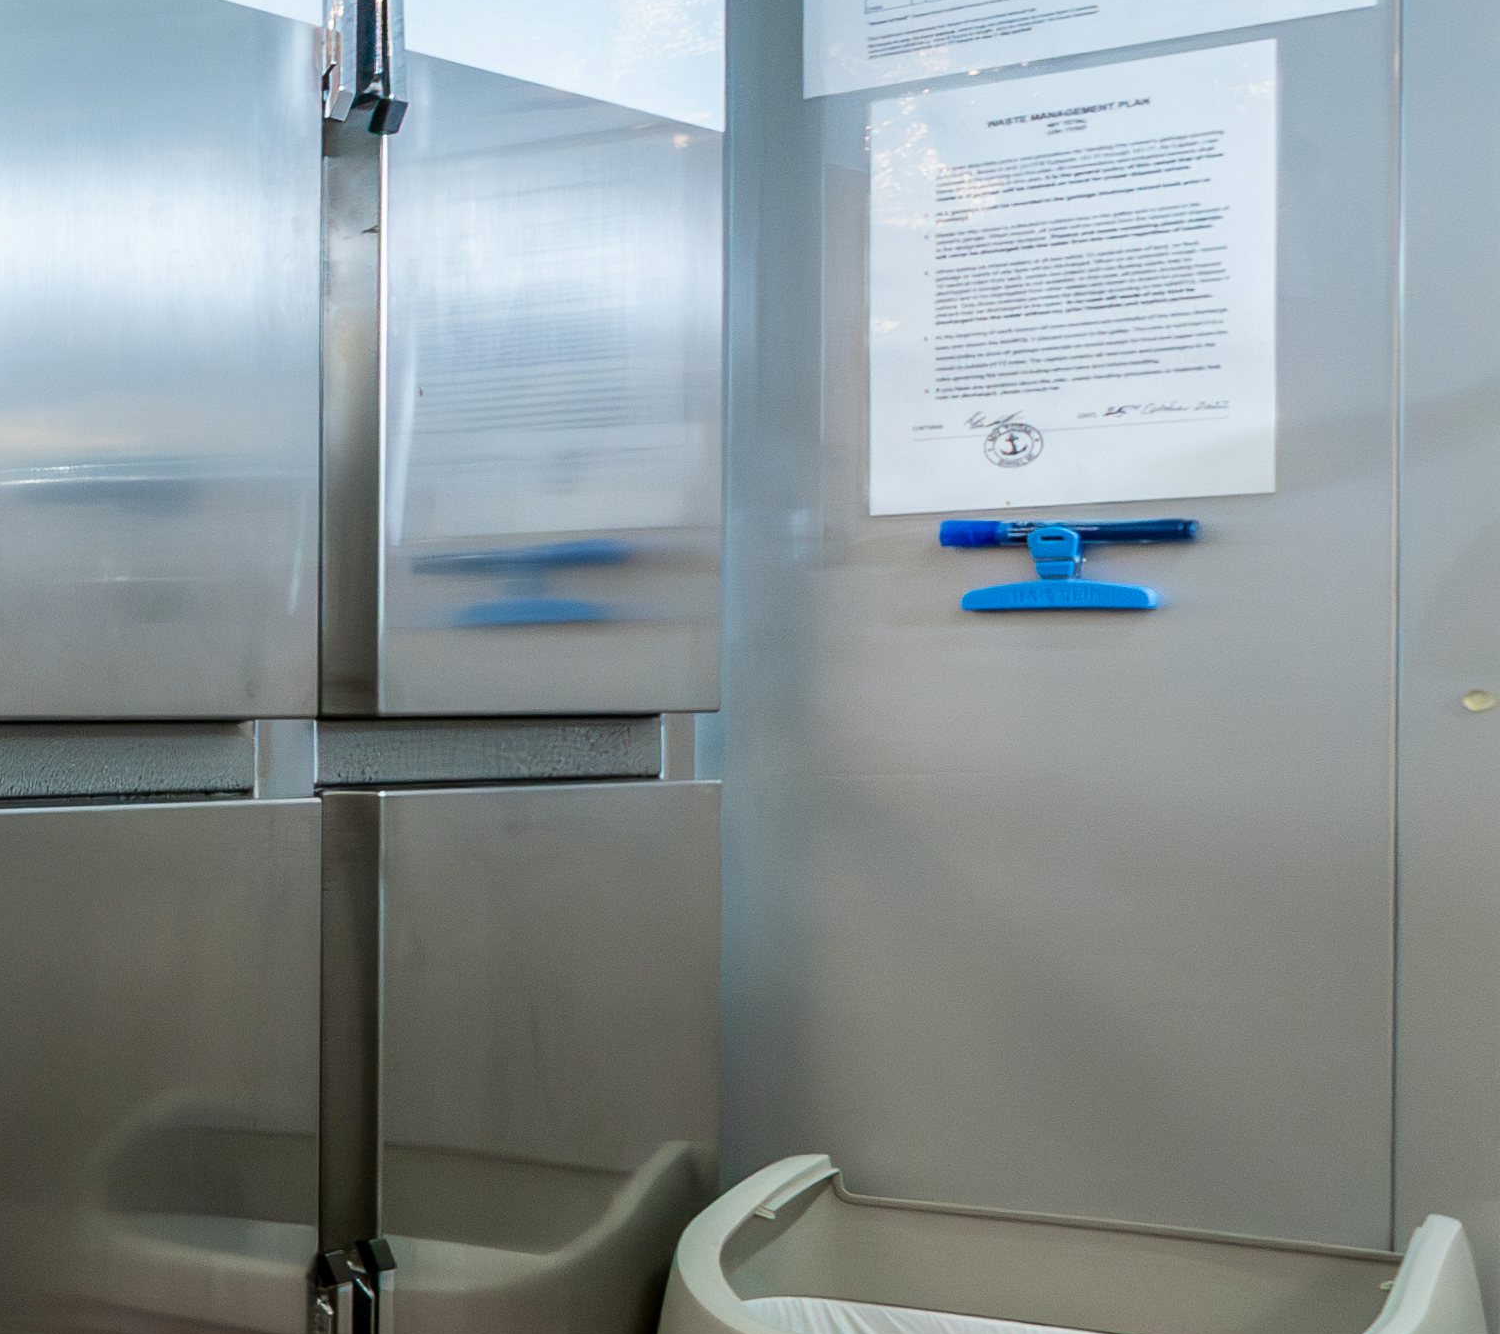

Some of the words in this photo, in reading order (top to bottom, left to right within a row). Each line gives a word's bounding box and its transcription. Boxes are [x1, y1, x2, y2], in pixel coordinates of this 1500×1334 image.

[987, 115, 1026, 128] WASTE
[1030, 101, 1114, 122] MANAGEMENT
[1117, 97, 1150, 108] PLAN
